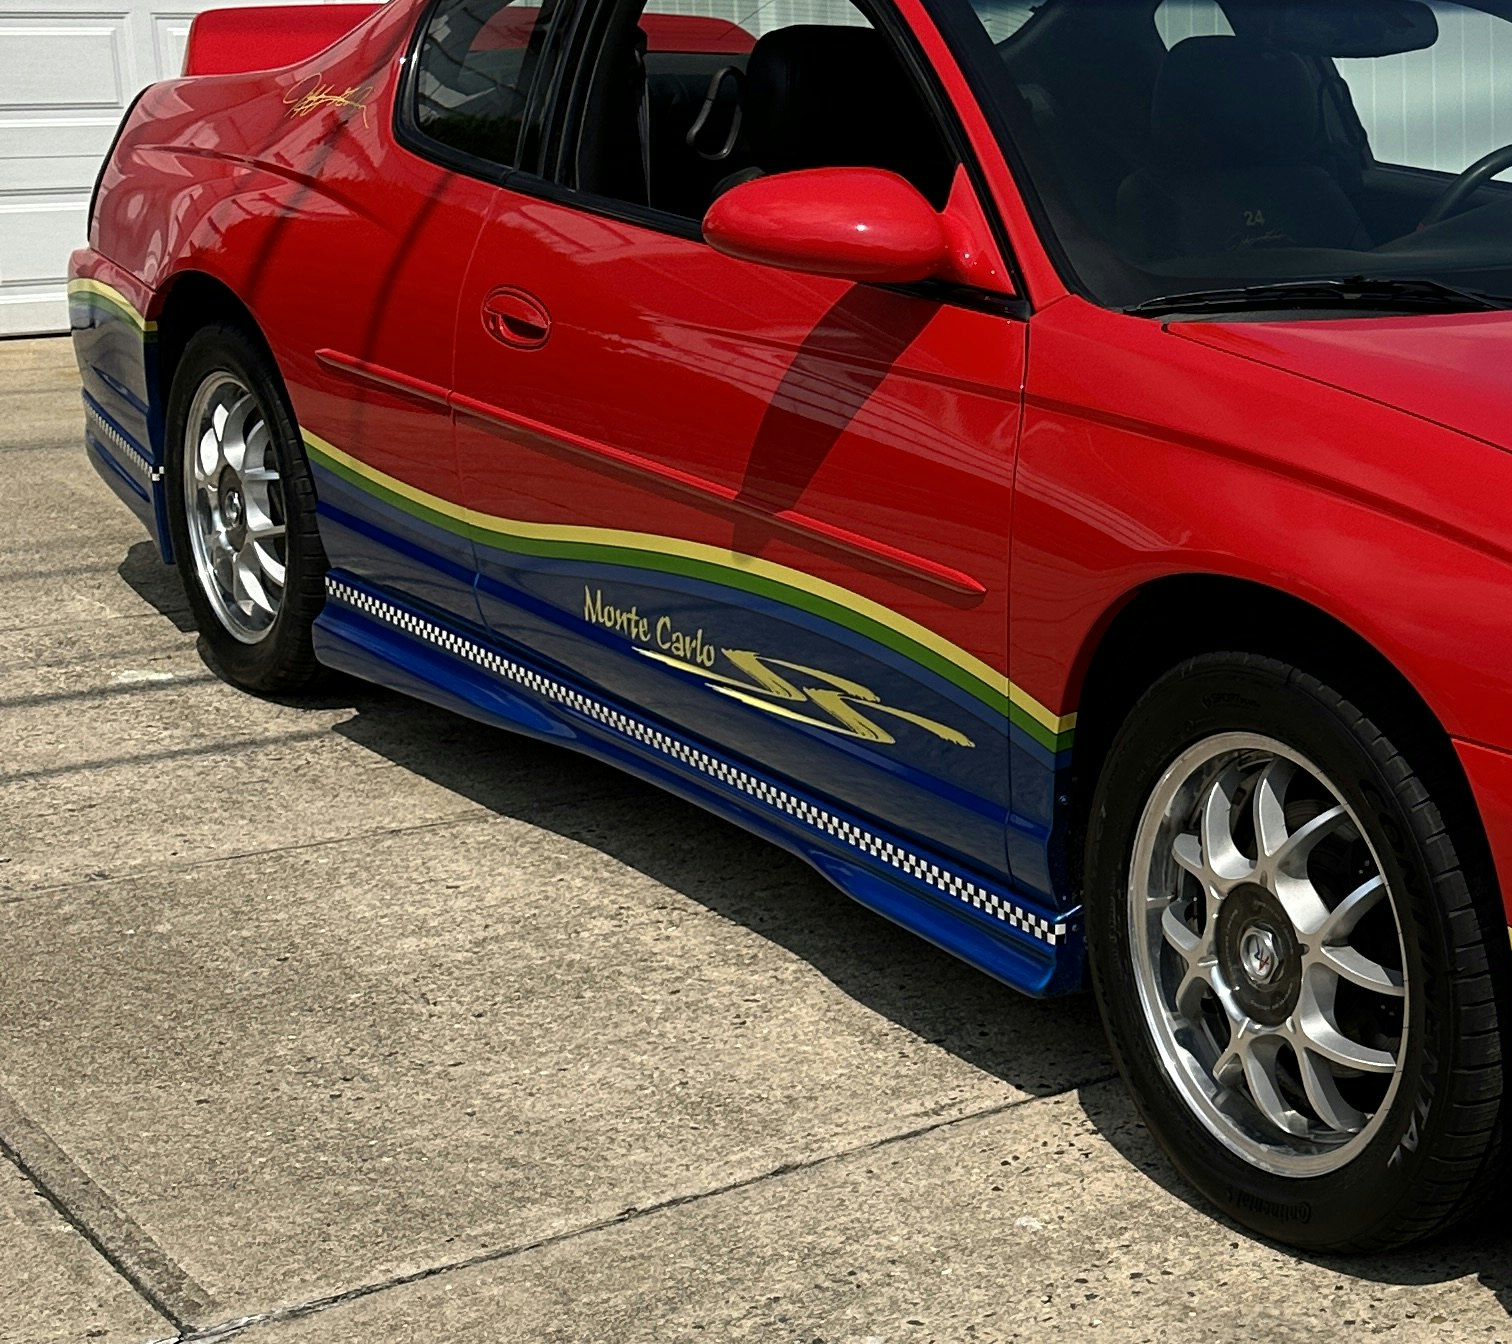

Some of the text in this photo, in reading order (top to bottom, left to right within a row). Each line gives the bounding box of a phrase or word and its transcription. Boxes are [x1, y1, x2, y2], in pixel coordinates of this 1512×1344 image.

[1243, 209, 1266, 226] 24
[583, 584, 651, 642] Monte
[655, 615, 716, 668] Carlo
[1236, 1189, 1312, 1225] Continental
